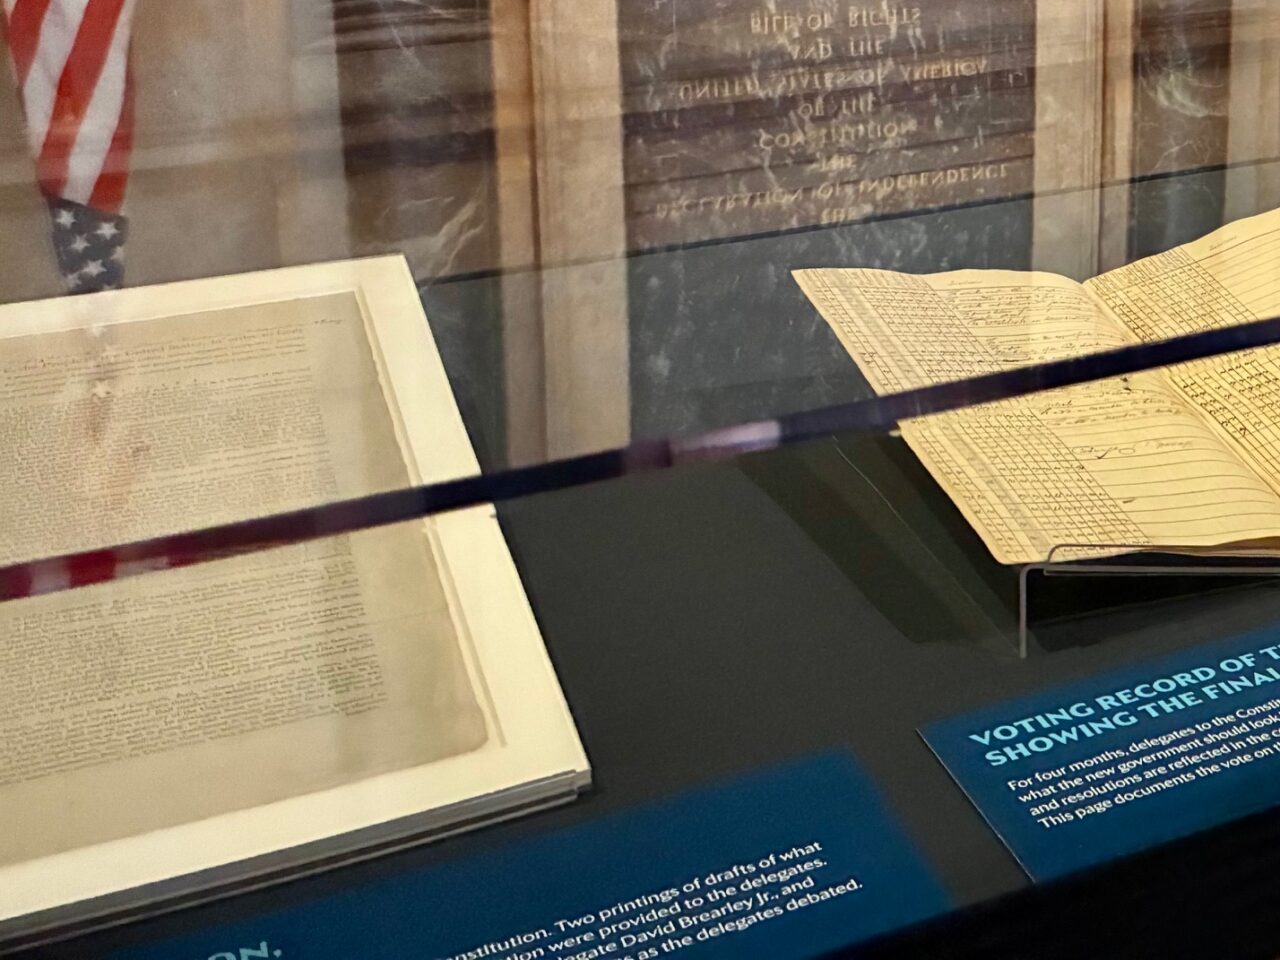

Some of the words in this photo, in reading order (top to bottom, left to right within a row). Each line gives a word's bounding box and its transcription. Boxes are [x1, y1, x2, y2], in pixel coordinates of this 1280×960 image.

[969, 702, 1094, 745] VOTING
[1095, 666, 1216, 710] RECORD
[1218, 652, 1255, 672] OF
[985, 710, 1137, 766] SHOWING
[1136, 690, 1203, 717] THE
[1036, 811, 1074, 828] This
[1074, 799, 1113, 819] page
[1113, 771, 1196, 804] documents
[1194, 763, 1221, 777] the
[1219, 753, 1254, 768] vote
[1253, 746, 1274, 758] on
[547, 931, 594, 952] were
[598, 901, 681, 939] provided
[683, 896, 704, 909] to
[705, 886, 737, 902] the
[739, 858, 827, 891] delegates.
[553, 913, 595, 932] Two
[598, 887, 680, 922] printings
[681, 876, 701, 893] of
[704, 863, 756, 886] drafts
[757, 852, 776, 869] of
[778, 841, 822, 861] what
[619, 920, 676, 948] David
[677, 897, 753, 929] Brearley
[780, 875, 815, 896] and
[637, 946, 659, 960] as
[660, 935, 693, 952] the
[695, 905, 783, 941] delegates
[785, 878, 863, 911] debated.
